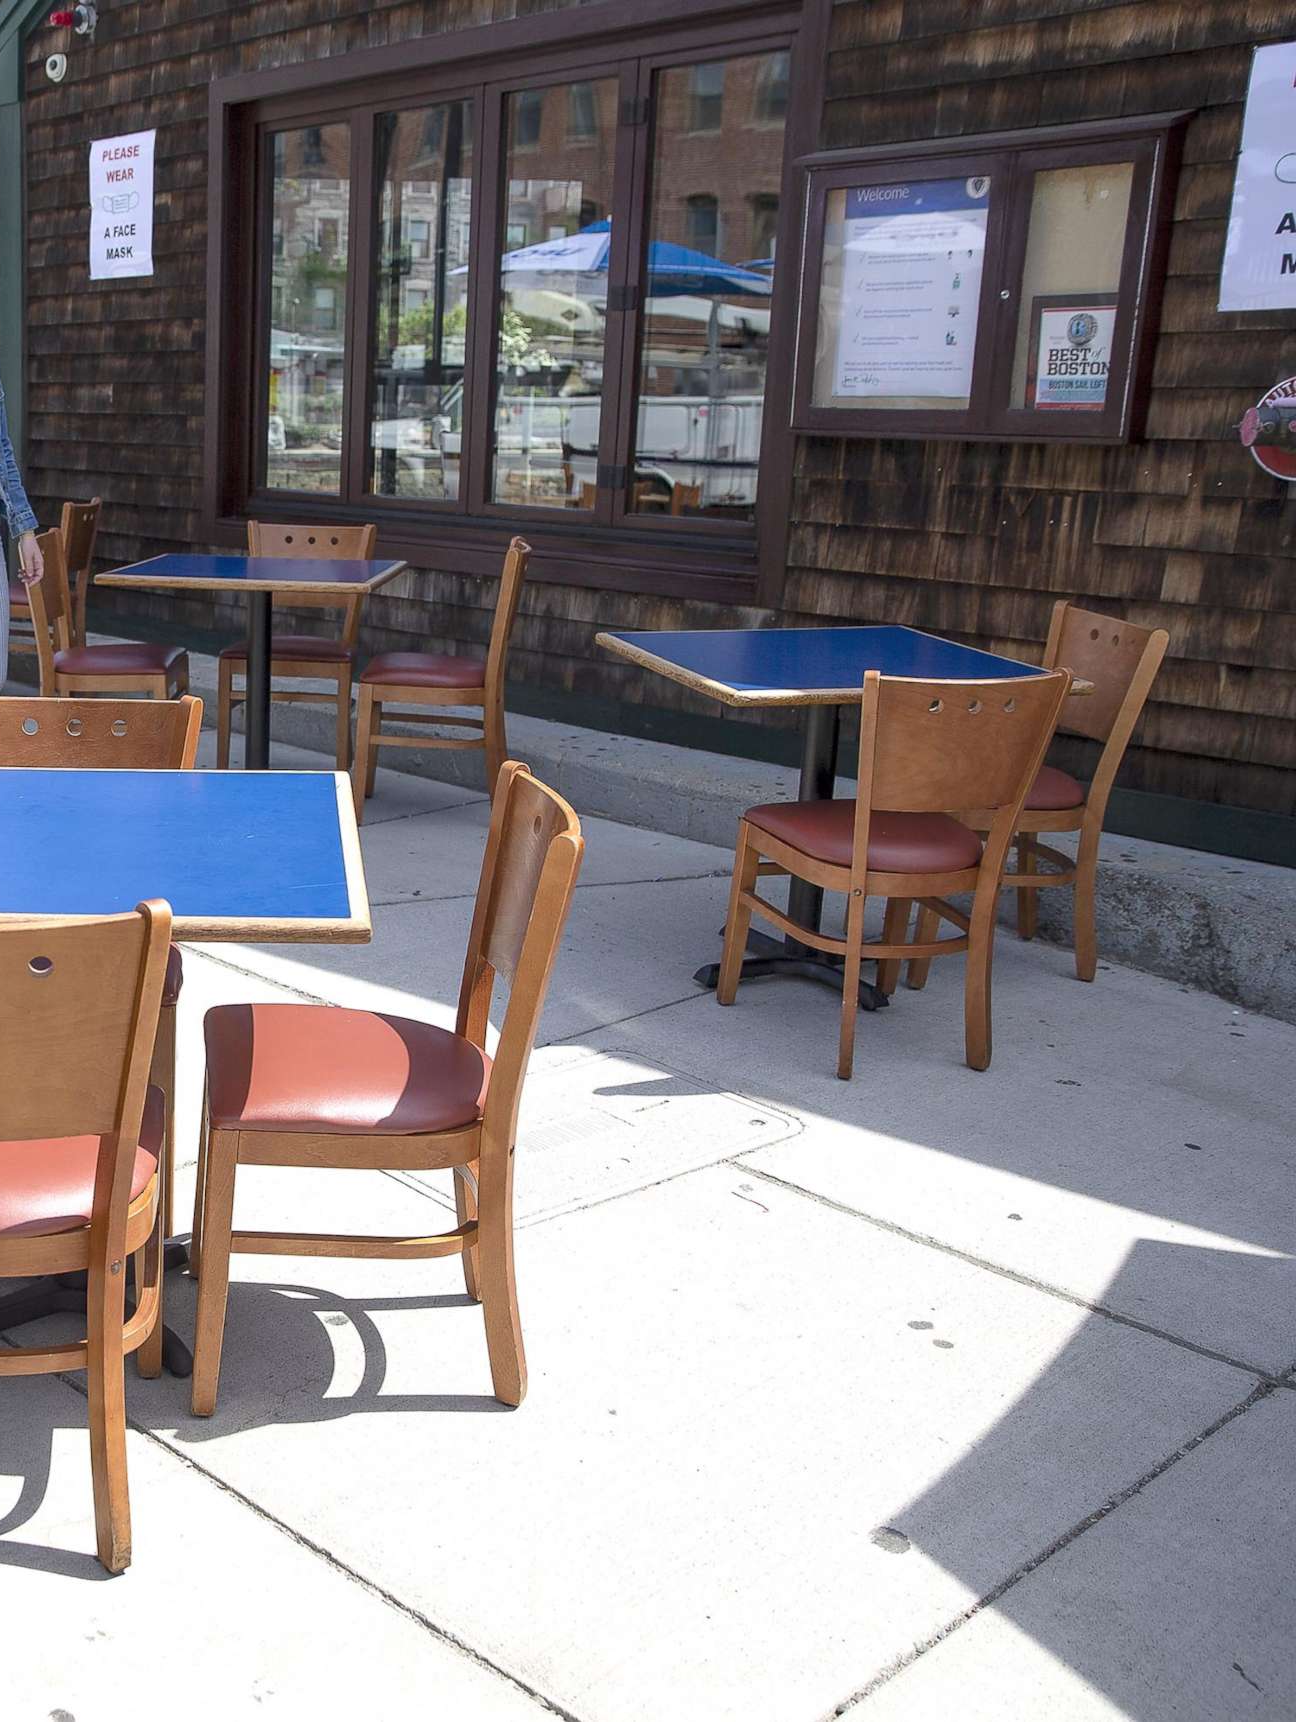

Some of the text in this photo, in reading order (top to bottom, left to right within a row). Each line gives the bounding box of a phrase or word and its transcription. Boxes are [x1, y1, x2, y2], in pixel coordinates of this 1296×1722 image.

[102, 144, 140, 162] PLEASE
[106, 168, 134, 183] WEAR
[857, 186, 910, 202] Welcome
[1275, 213, 1296, 234] A
[104, 224, 136, 239] A FACE
[106, 246, 133, 260] MASK
[1047, 348, 1091, 361] BEST
